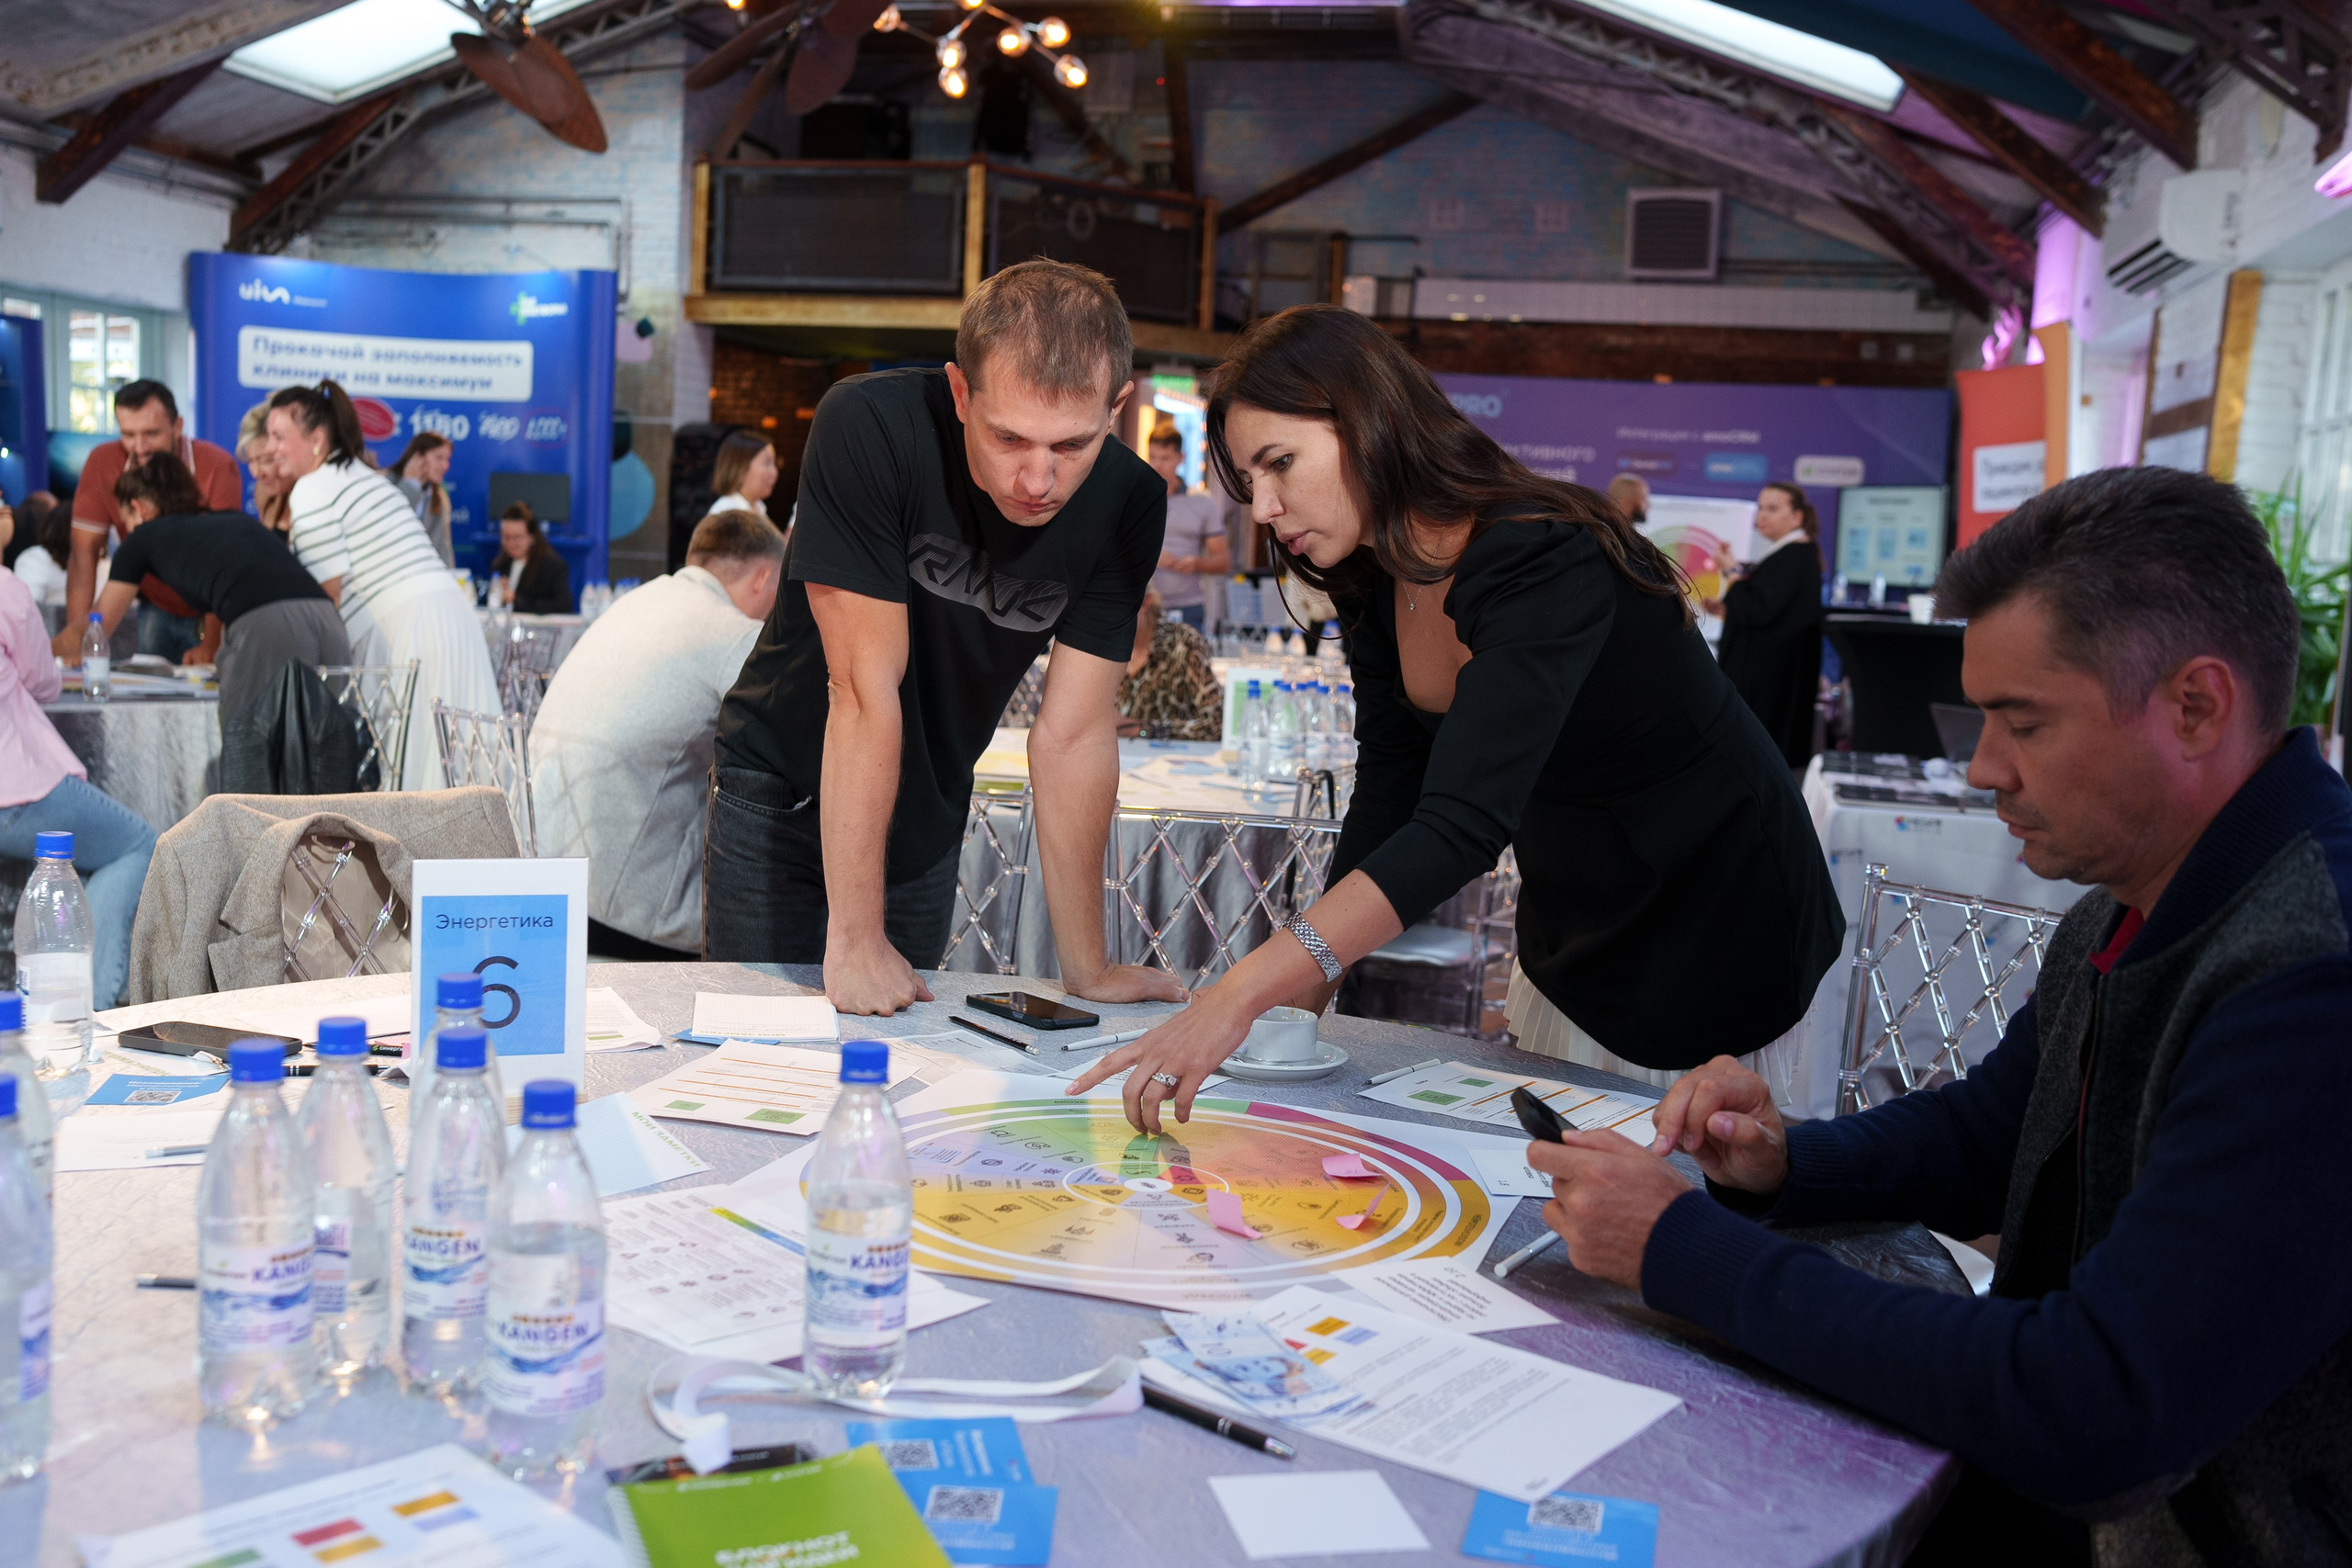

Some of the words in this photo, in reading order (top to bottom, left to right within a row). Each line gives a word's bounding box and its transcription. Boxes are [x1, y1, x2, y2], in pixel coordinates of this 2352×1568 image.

[253, 336, 364, 359] Прокачай
[371, 347, 523, 366] заполняемость
[354, 370, 380, 386] на
[386, 372, 492, 393] максимум
[435, 914, 554, 931] Энергетика
[470, 955, 521, 1030] 6
[630, 1111, 656, 1131] МОИ
[655, 1130, 701, 1168] ЗАМЕТКИ
[404, 1236, 481, 1256] ANGEN
[498, 1320, 590, 1343] KANGEN
